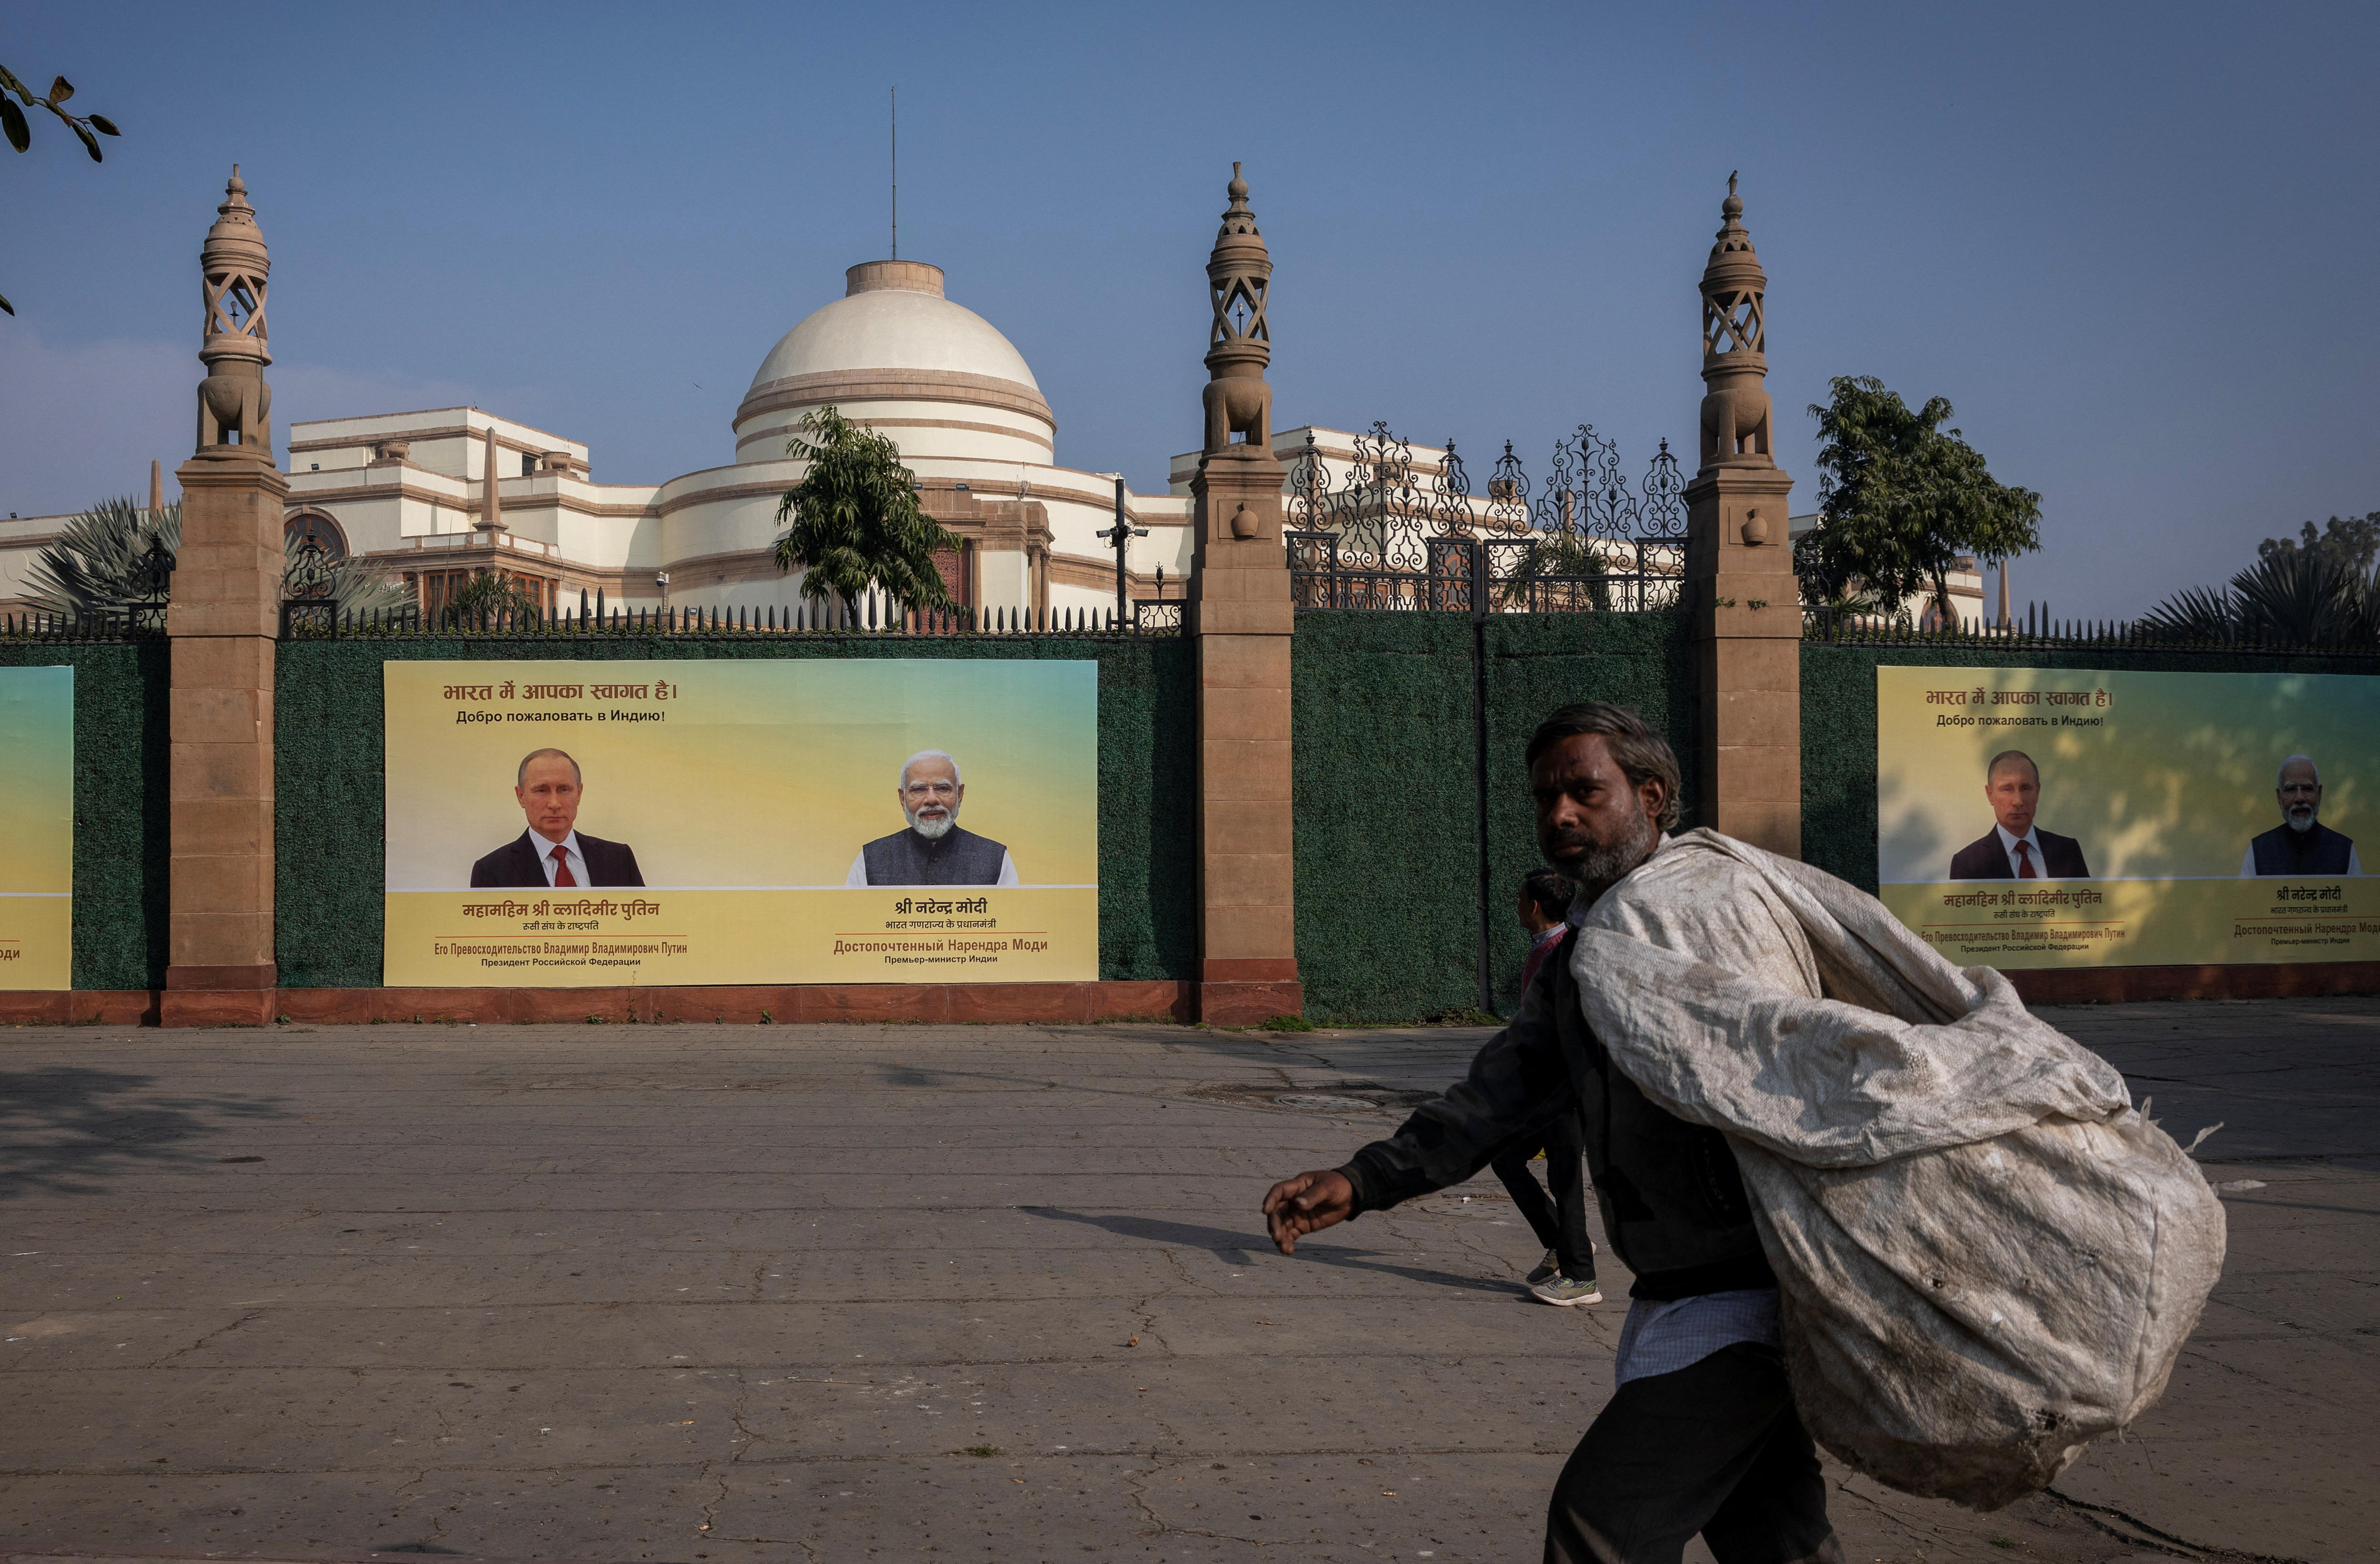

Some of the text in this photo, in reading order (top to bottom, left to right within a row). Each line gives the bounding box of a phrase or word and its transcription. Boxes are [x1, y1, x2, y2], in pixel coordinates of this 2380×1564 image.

[443, 679, 677, 701] भारत में आपका स्वागत है।
[1926, 687, 2112, 707] भारत में आपका स्वागत है।
[456, 709, 665, 725] Добро пожаловать в Индию!
[1936, 714, 2103, 728] Добро пожаловать в Индию!
[1944, 889, 2102, 908] महामहिम श्री व्लादिमीर पुतिन
[2276, 886, 2342, 901] श्री नरेन्द्र मोदी
[462, 899, 661, 921] महामहिम श्री व्लादिमीर पुतिन
[894, 897, 988, 915] श्री नरेन्द्र मोदी
[522, 920, 600, 931] रूसी संघ के राष्ट्रपति
[885, 918, 997, 929] भारत गणराज्य के प्रधानमंत्री
[2234, 924, 2312, 937] Достопочтенный
[2315, 923, 2357, 936] Нарендра
[1921, 927, 2125, 944] Его Превосходительство Владимир Владимирович Путин
[2271, 937, 2329, 946] Премьер-министр
[435, 941, 687, 956] Его Превосходительство Владимир Владимирович Путин
[833, 938, 1048, 955] Достопочтенный Нарендра Моди
[1961, 943, 2089, 953] Президент Российской Федерации
[481, 957, 641, 968] Президент Российской Федерации
[884, 955, 998, 966] Премьер-министр Индии
